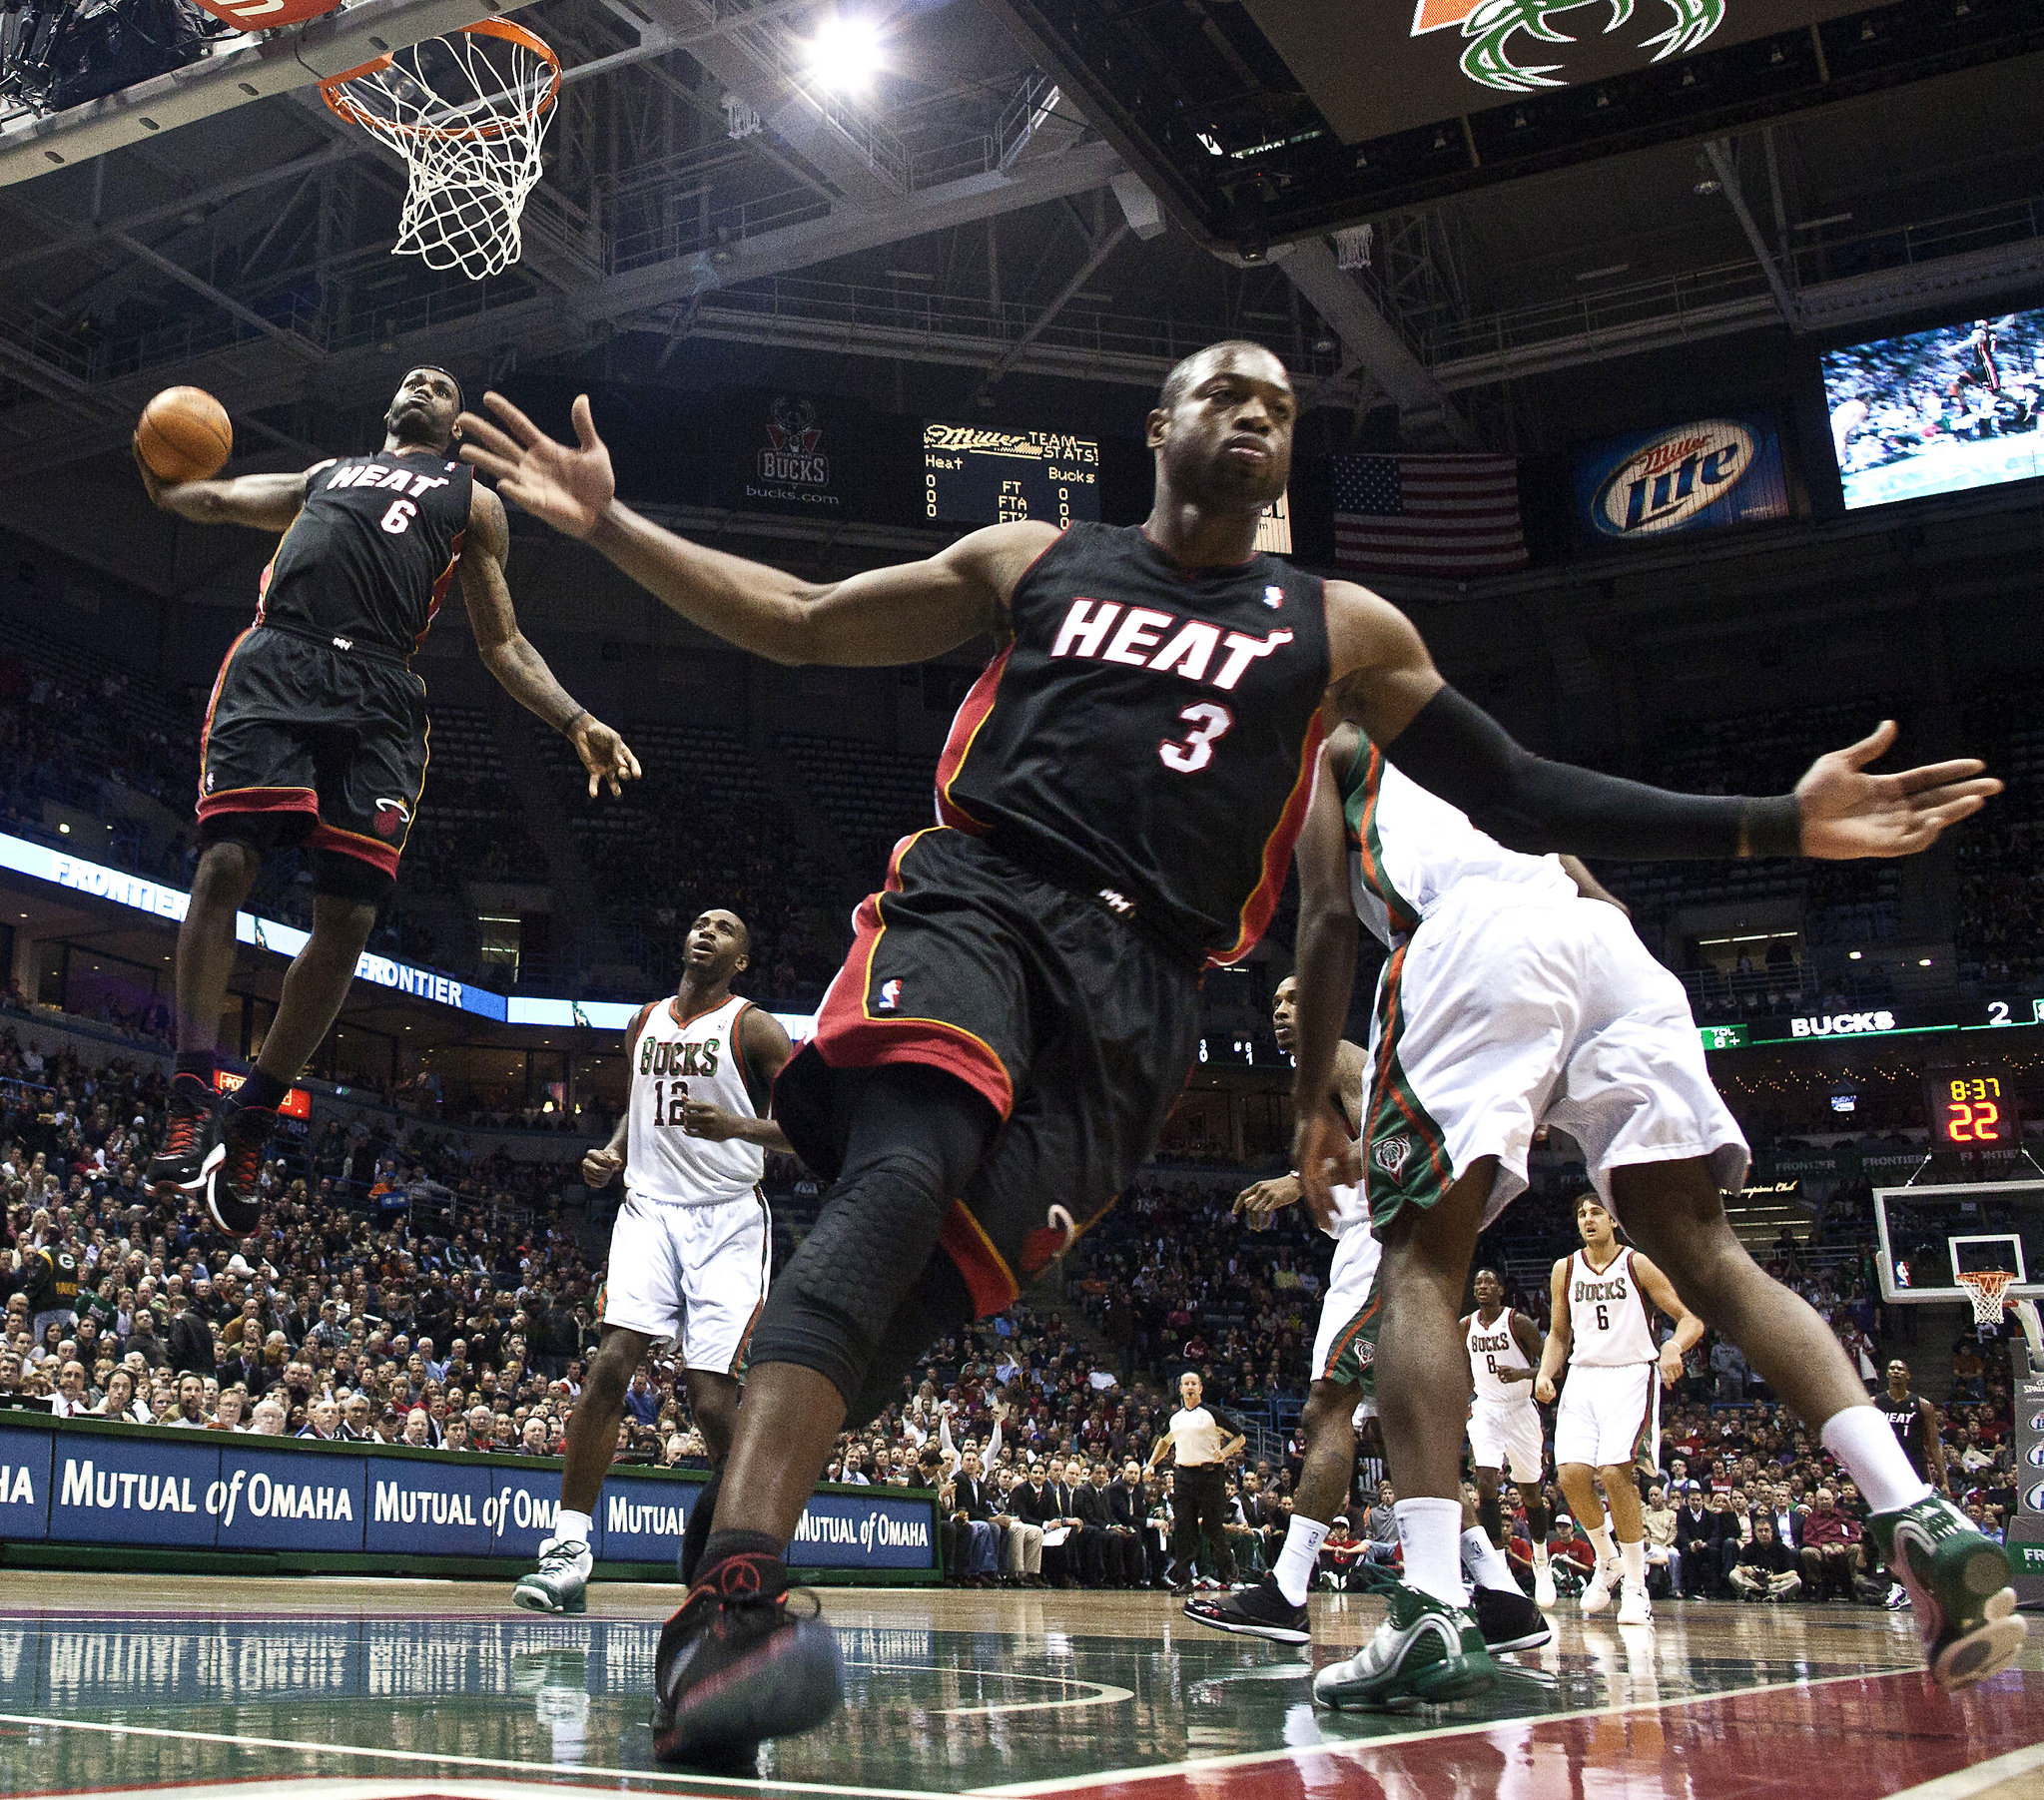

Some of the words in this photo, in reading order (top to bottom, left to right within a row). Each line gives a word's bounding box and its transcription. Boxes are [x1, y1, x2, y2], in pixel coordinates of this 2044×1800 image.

[927, 424, 1025, 450] Miller
[1028, 431, 1076, 448] TEAM
[764, 452, 825, 483] BUCKS
[925, 454, 964, 470] Heat
[1643, 435, 1713, 473] Miller
[326, 464, 450, 498] HEAT
[926, 474, 936, 487] 0
[1003, 480, 1022, 495] FT
[1058, 487, 1068, 501] 0
[1048, 466, 1095, 484] Bucks
[1622, 442, 1738, 533] Lite
[746, 485, 840, 505] bucks.com
[927, 489, 937, 502] 0
[999, 495, 1027, 511] FTA
[1059, 503, 1069, 517] 0
[927, 504, 937, 517] 0
[379, 499, 418, 534] 6
[1049, 596, 1294, 693] HEAT
[1158, 699, 1234, 774] 3
[58, 856, 191, 923] FRONTIER
[354, 951, 462, 1008] FRONTIER
[1790, 1010, 1896, 1037] BUCKS
[1987, 1001, 2012, 1025] 2
[639, 1035, 721, 1077] BUCKS
[654, 1080, 689, 1127] 12
[1950, 1077, 2001, 1102] 8:37
[1947, 1101, 1999, 1141] 22
[1574, 1277, 1628, 1303] BUCKS
[1596, 1304, 1610, 1331] 6
[1471, 1332, 1510, 1353] BUCKS
[1903, 1425, 1910, 1437] 1
[61, 1459, 197, 1513] MUTUAL
[205, 1470, 247, 1527] of
[248, 1472, 353, 1521] OMAHA
[373, 1480, 477, 1526] MUTUAL
[482, 1487, 512, 1537] of
[607, 1496, 687, 1535] MUTUAL
[794, 1508, 858, 1544] MUTUAL
[859, 1511, 878, 1554] of
[878, 1513, 929, 1547] OMAHA
